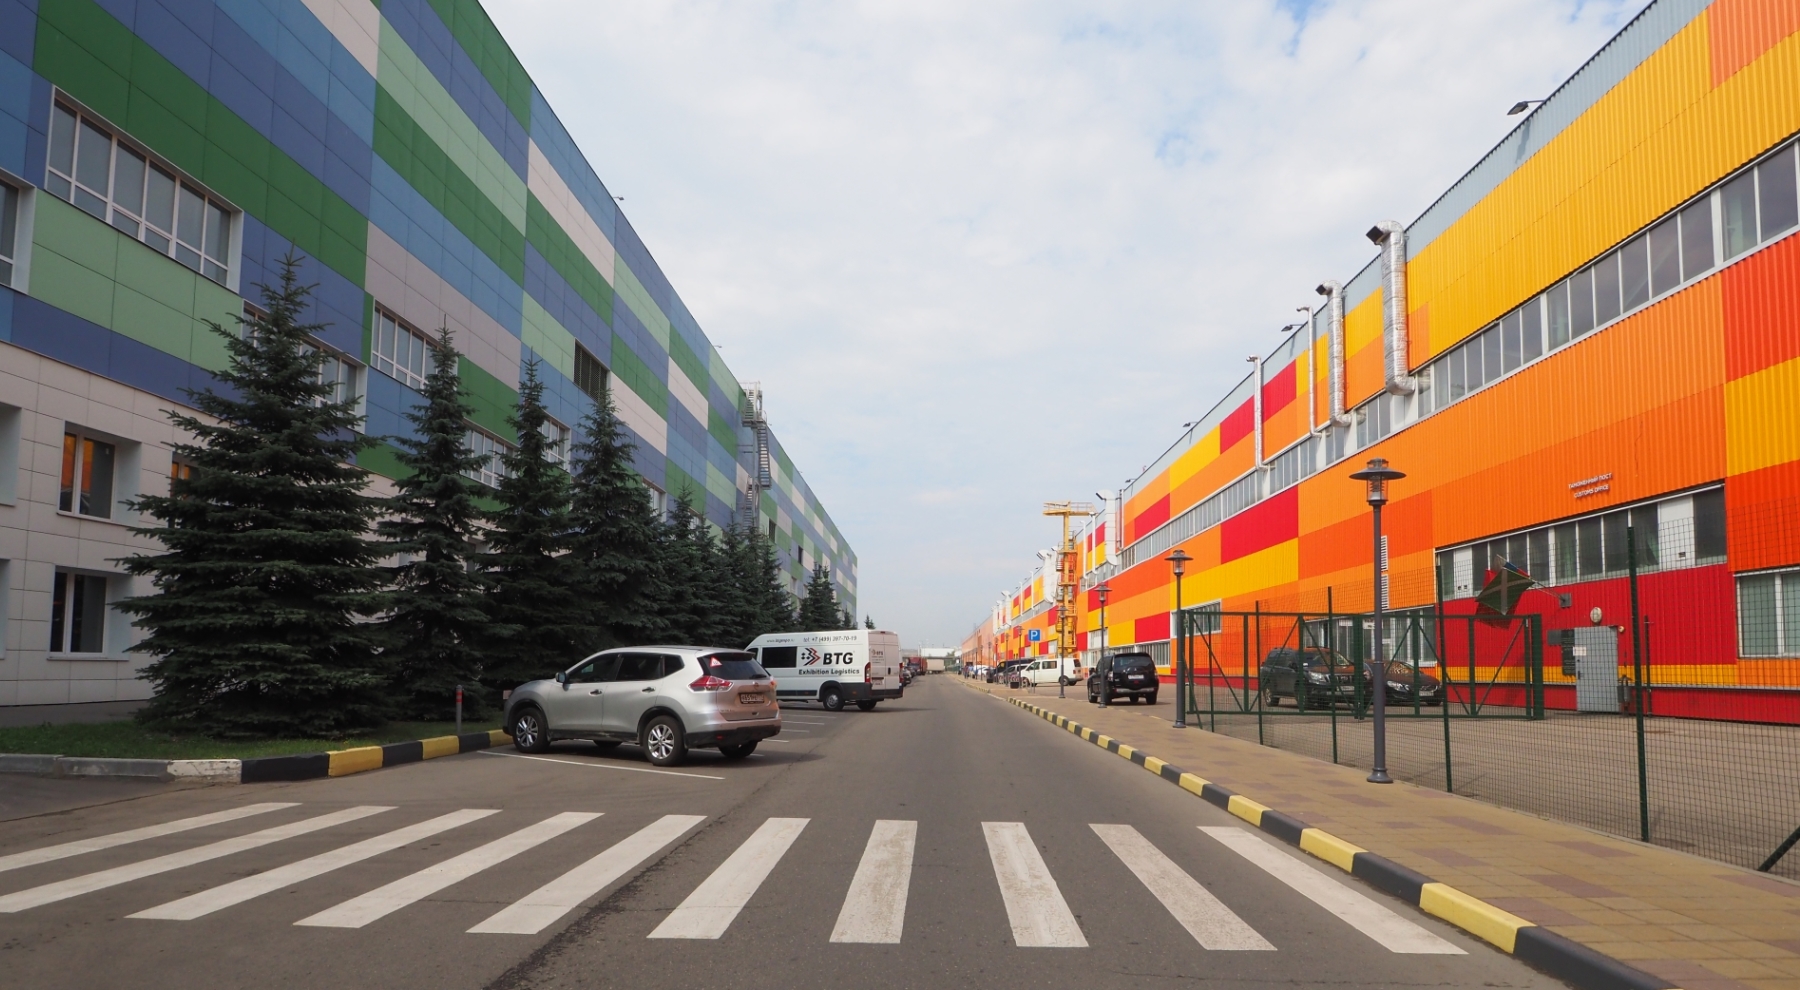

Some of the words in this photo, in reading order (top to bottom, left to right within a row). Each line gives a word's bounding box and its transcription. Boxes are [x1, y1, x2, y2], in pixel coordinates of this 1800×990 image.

[1598, 472, 1612, 481] ПОСТ
[1574, 488, 1594, 498] CUSTOMS
[1594, 483, 1609, 493] OFFICE
[1031, 630, 1038, 640] P
[823, 652, 853, 665] BTG
[830, 668, 860, 676] Logistics
